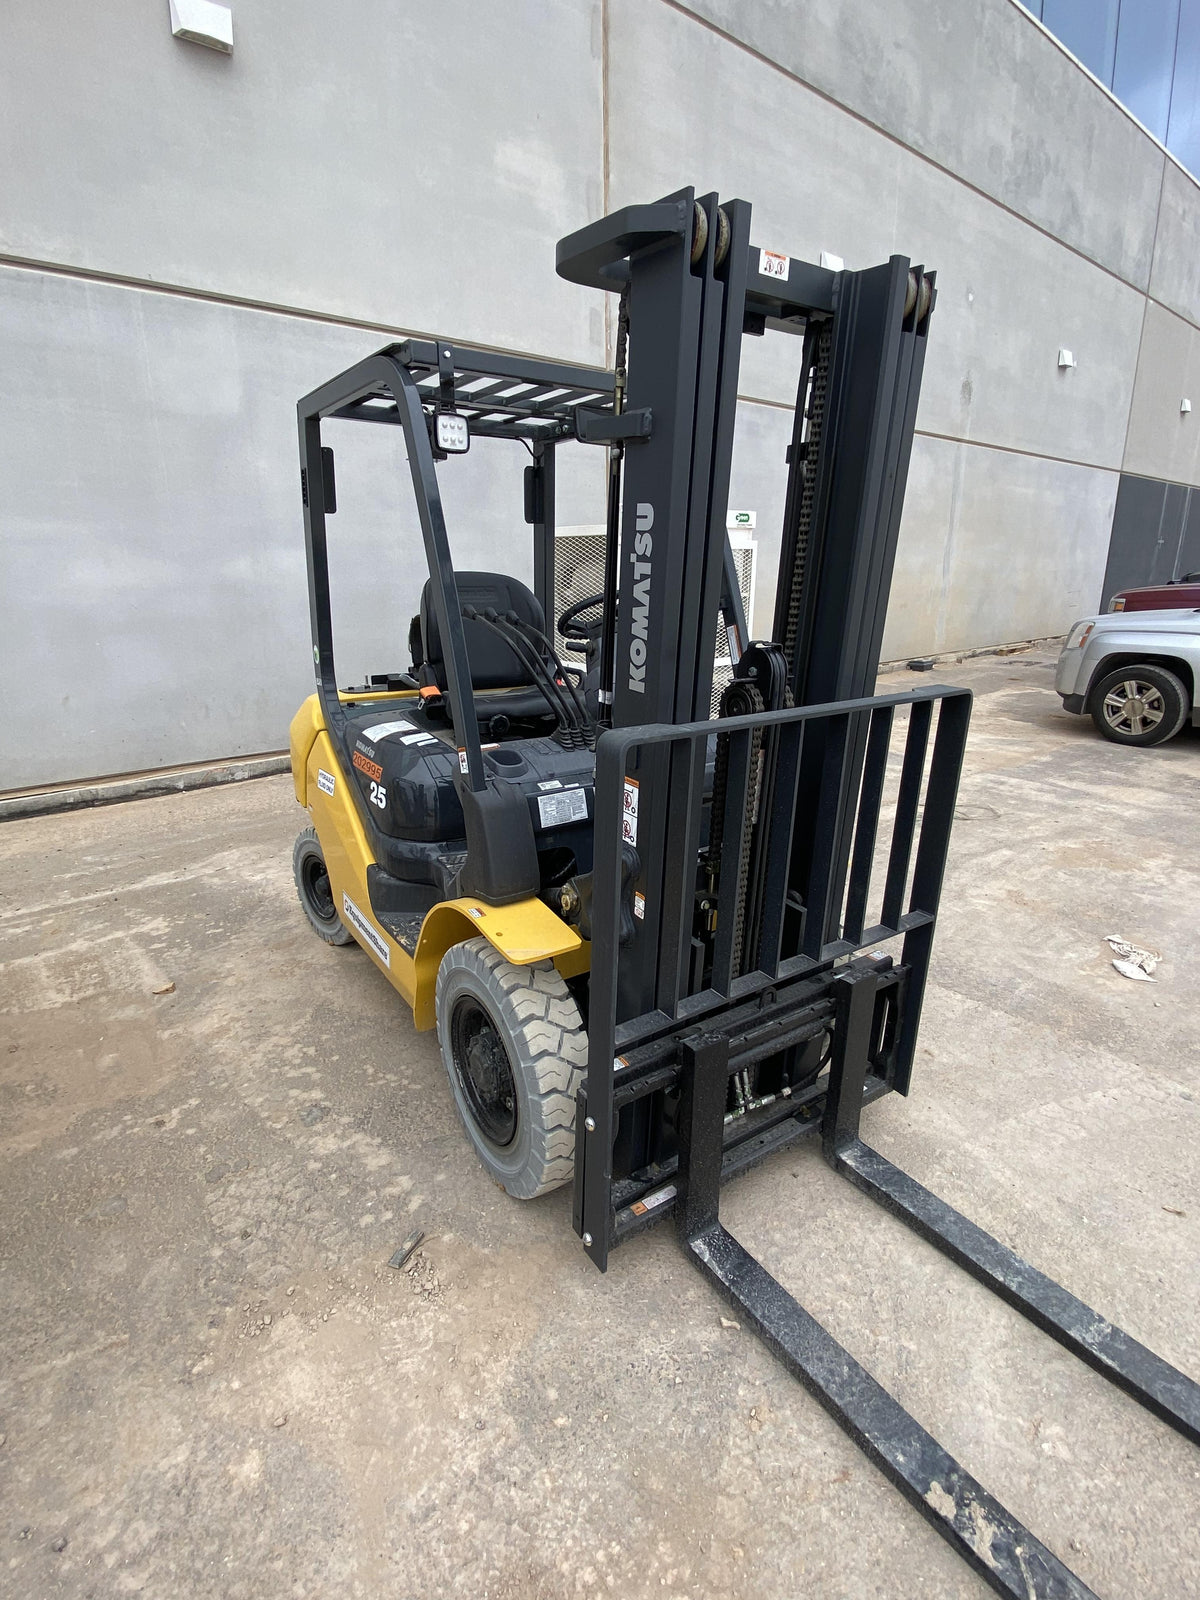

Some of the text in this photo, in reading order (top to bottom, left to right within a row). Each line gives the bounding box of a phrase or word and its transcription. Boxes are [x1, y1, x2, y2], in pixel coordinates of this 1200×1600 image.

[629, 503, 654, 693] KOMATSU
[353, 753, 381, 779] 202995
[370, 781, 386, 809] 25
